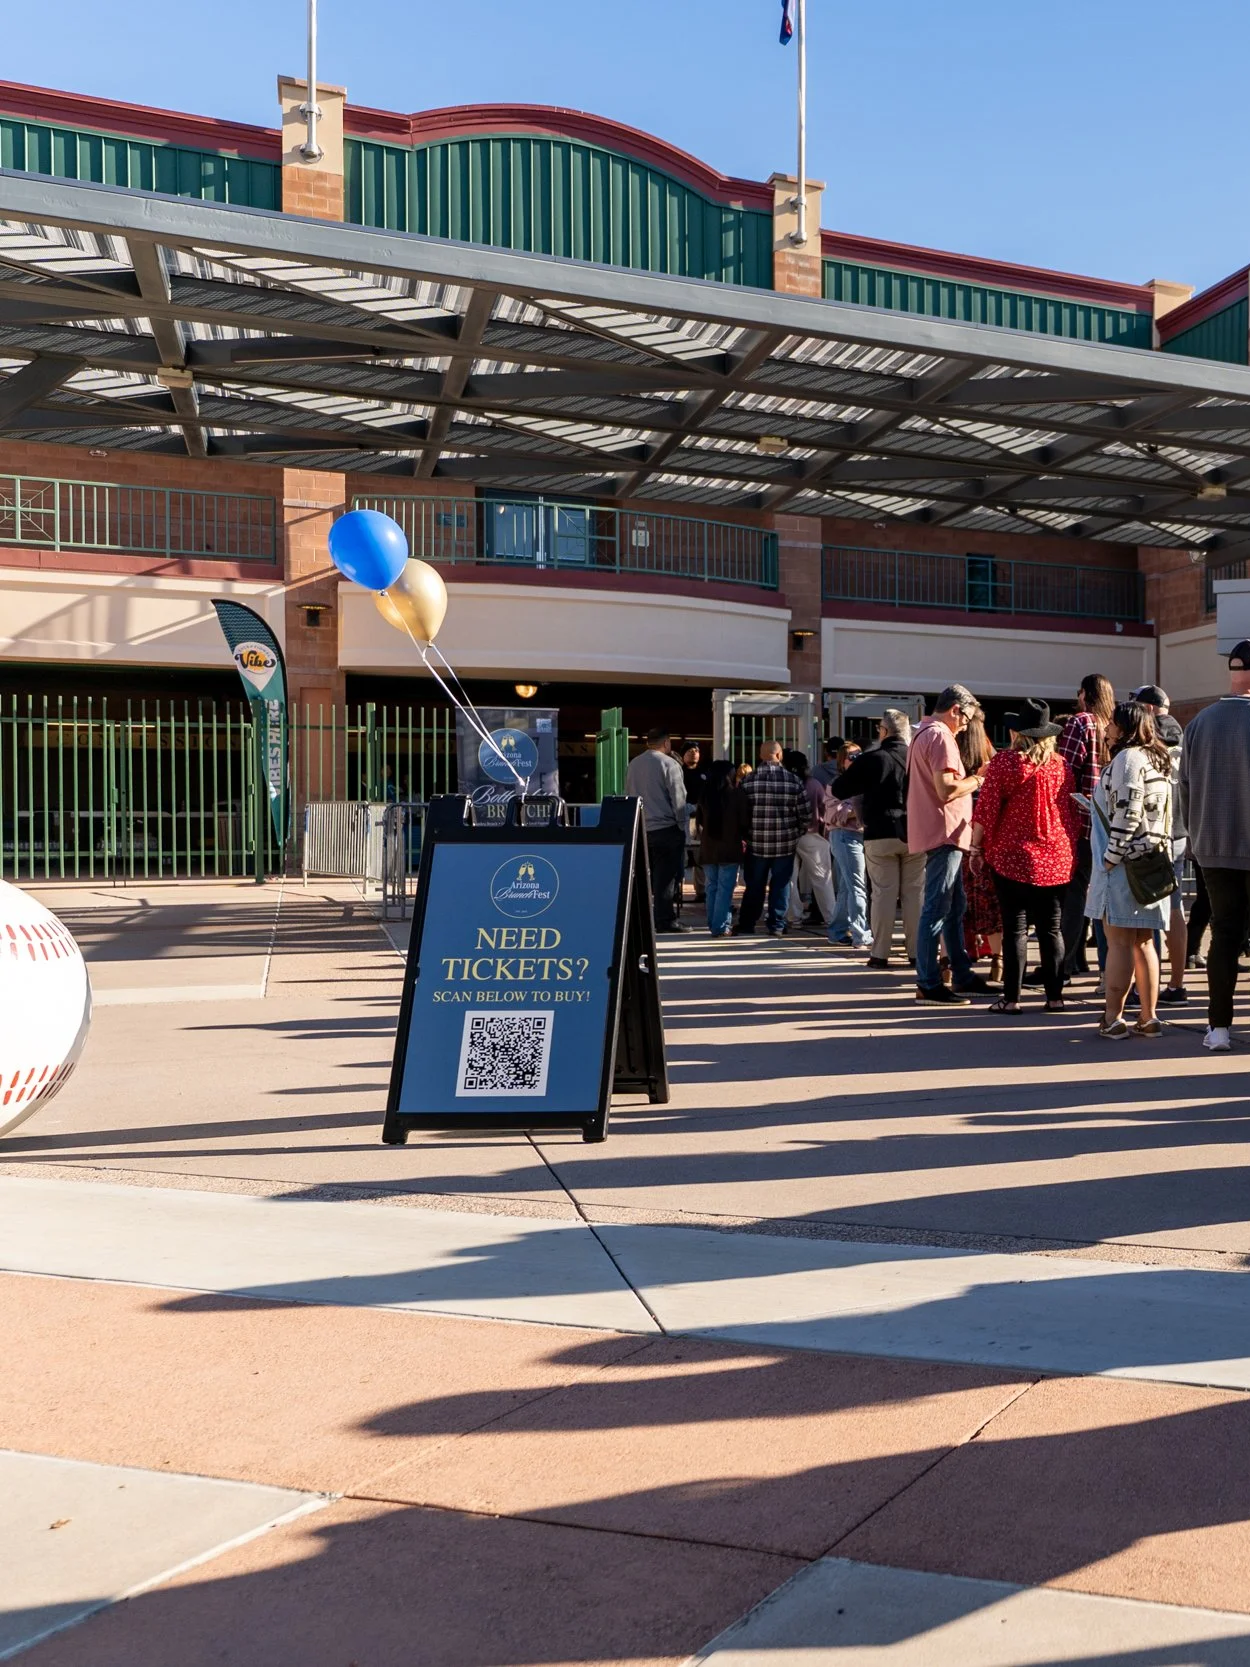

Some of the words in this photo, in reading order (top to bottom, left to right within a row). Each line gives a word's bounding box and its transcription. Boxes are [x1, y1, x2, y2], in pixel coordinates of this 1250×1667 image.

[234, 649, 277, 669] Vibe
[487, 804, 551, 818] BRCH!
[511, 881, 540, 889] Arizona
[475, 927, 562, 950] NEED
[441, 957, 589, 981] TICKETS?
[432, 991, 472, 1003] SCAN
[475, 991, 528, 1002] BELOW
[531, 991, 551, 1002] TO
[553, 991, 590, 1002] BUY!
